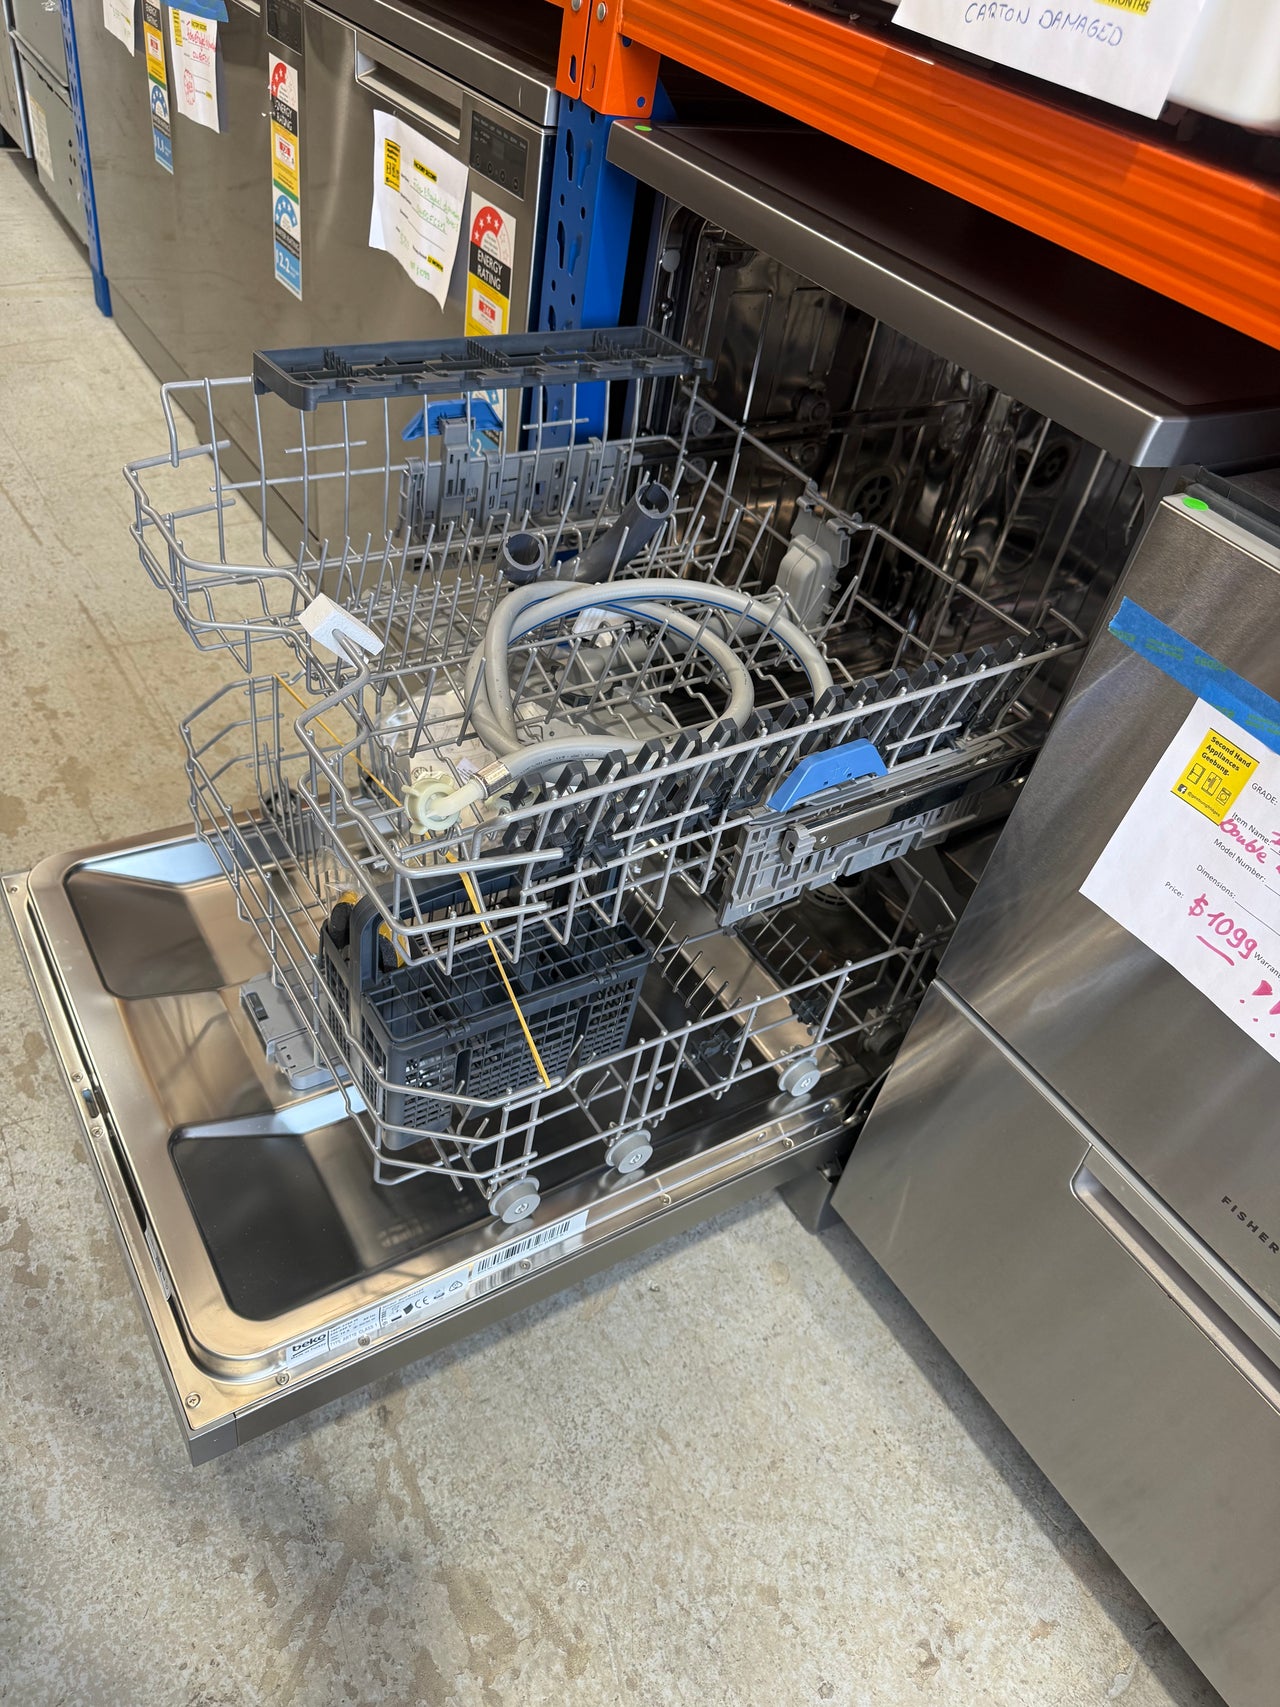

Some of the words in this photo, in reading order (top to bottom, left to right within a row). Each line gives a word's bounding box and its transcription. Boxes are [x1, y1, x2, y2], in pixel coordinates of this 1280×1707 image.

[964, 2, 1031, 25] CARTON
[1038, 9, 1124, 47] DAMAGED
[476, 264, 502, 291] RATING
[477, 250, 503, 276] ENERGY
[1201, 752, 1230, 776] Geebung.
[1206, 744, 1240, 771] Appliances
[1211, 736, 1235, 756] Second
[1234, 752, 1252, 768] Hand
[1251, 782, 1279, 806] GRADE:
[1220, 818, 1267, 864] Double
[1231, 812, 1249, 828] Item
[1248, 824, 1272, 846] Name:
[1213, 838, 1236, 860] Model
[1235, 855, 1267, 883] Number:
[1164, 881, 1185, 899] Price:
[1196, 864, 1237, 899] Dimensions:
[1188, 893, 1258, 959] $1099
[1221, 1195, 1280, 1254] FISHER
[292, 1333, 326, 1352] beko
